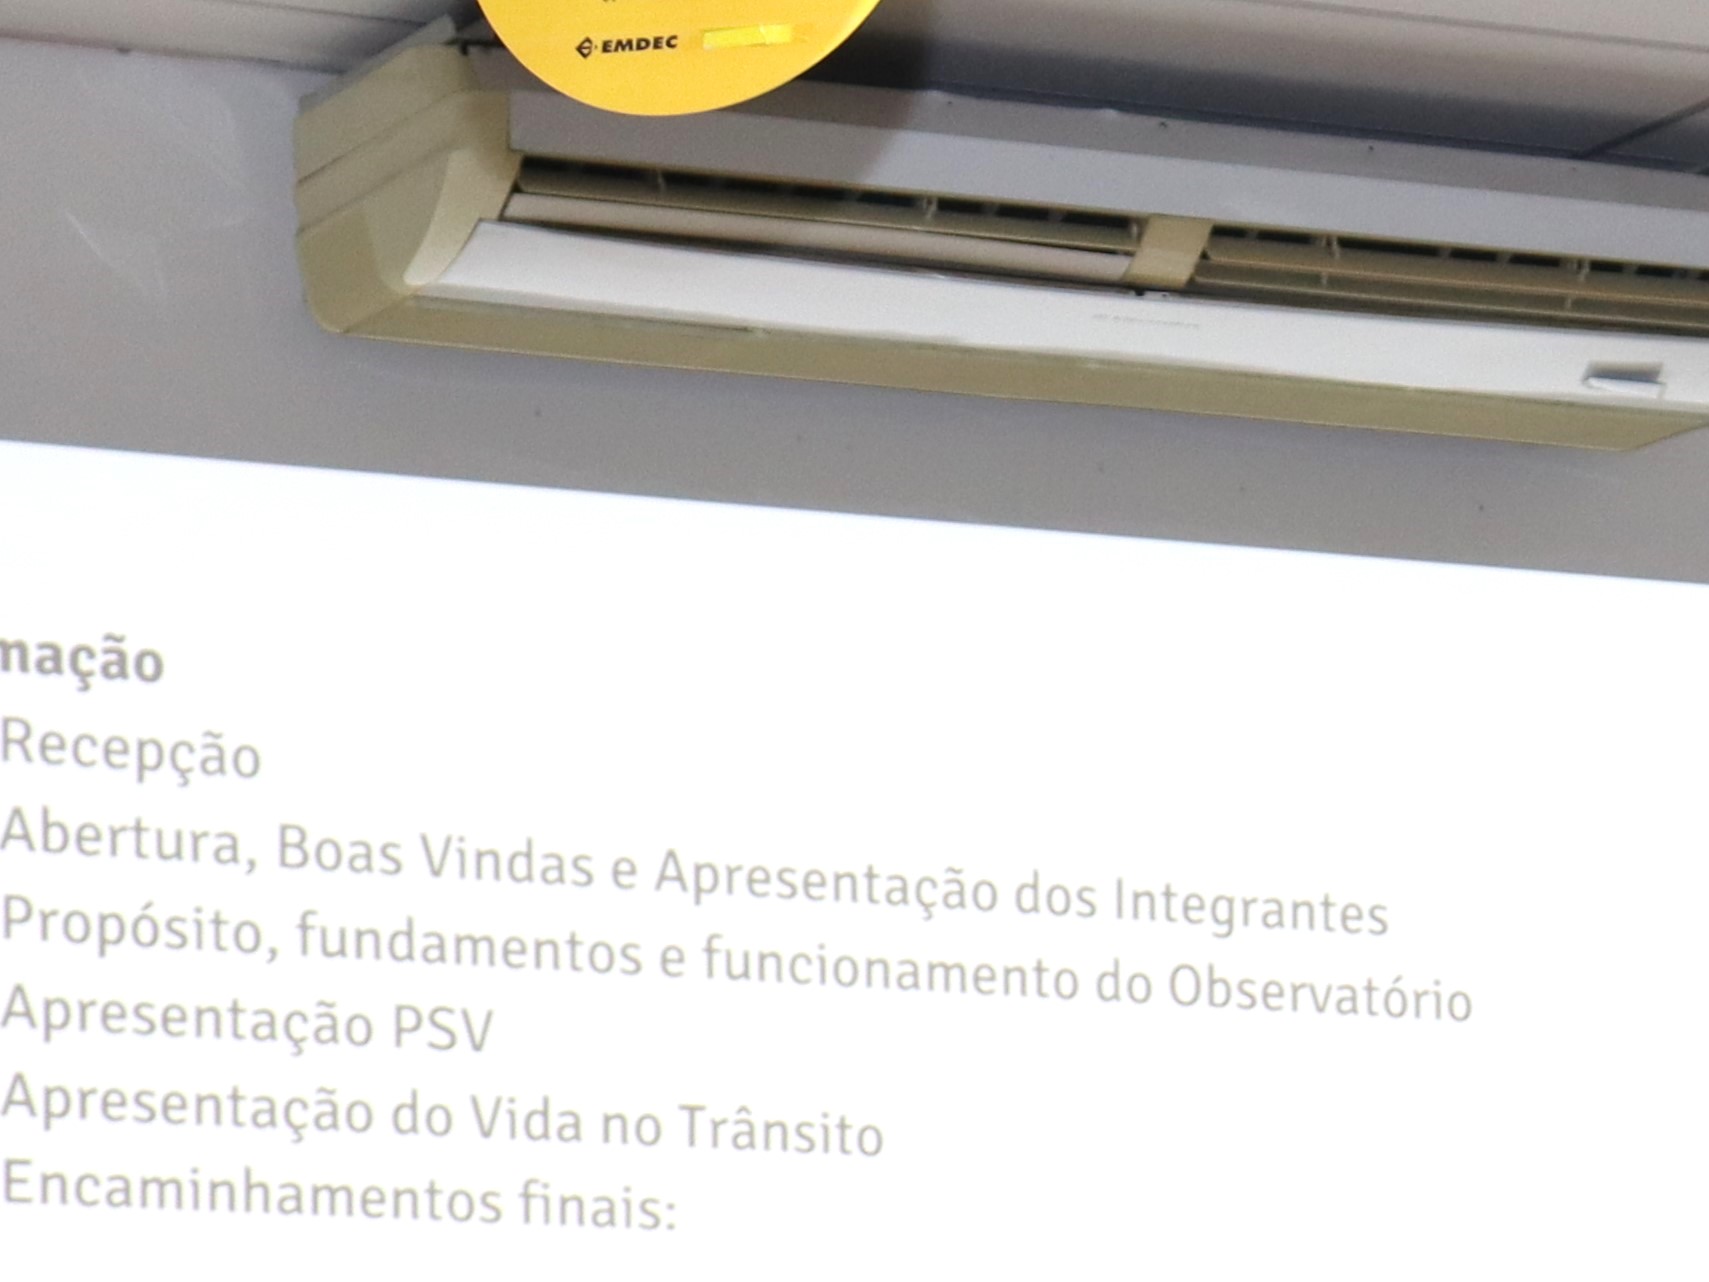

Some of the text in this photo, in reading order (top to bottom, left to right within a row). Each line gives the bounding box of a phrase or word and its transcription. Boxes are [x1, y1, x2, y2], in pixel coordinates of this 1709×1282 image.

[601, 35, 678, 54] EMDEC
[1, 716, 261, 787] Recepção
[0, 805, 1388, 939] Abertura, Boas Vindas e Apresentação dos Integrantes
[3, 894, 1472, 1022] Propósito, fundamentos e funcionamento do Observatório
[0, 983, 493, 1056] Apresentação PSV
[0, 1071, 883, 1157] Apresentação do Vida no Trânsito
[4, 1158, 675, 1230] Encaminhamentos finais:
